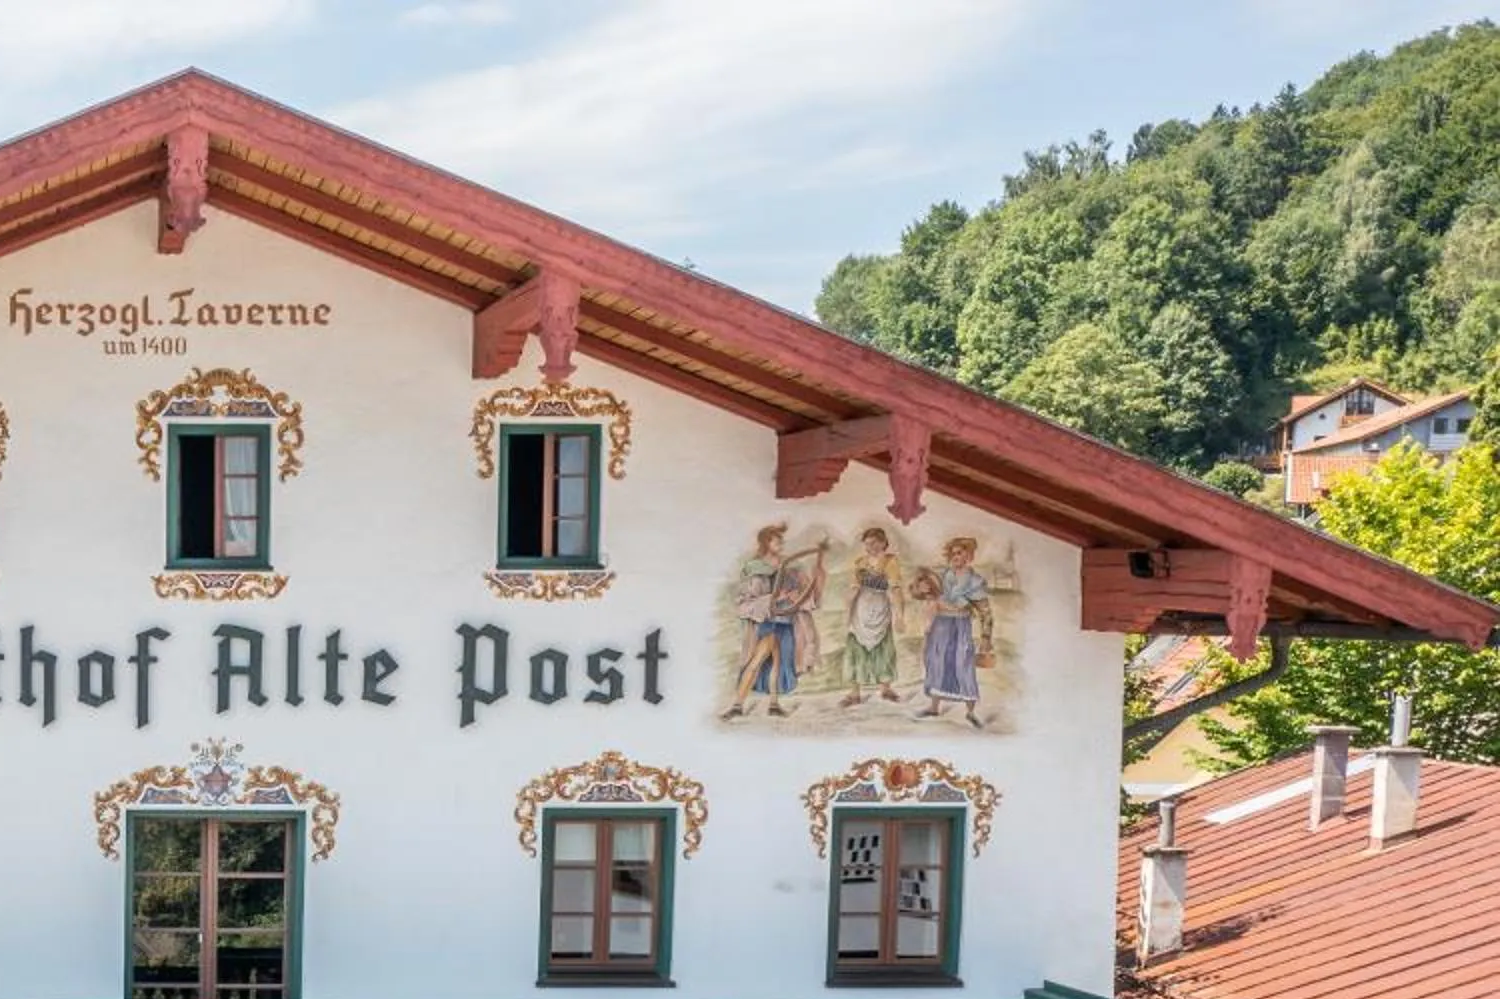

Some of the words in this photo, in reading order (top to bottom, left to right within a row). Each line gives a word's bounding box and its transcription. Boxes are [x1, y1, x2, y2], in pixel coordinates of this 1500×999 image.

[9, 288, 162, 336] Herzogl.
[168, 288, 332, 326] Taverne
[102, 339, 138, 356] um
[142, 337, 188, 356] 1400
[211, 624, 400, 714] Alte
[454, 622, 670, 728] Post
